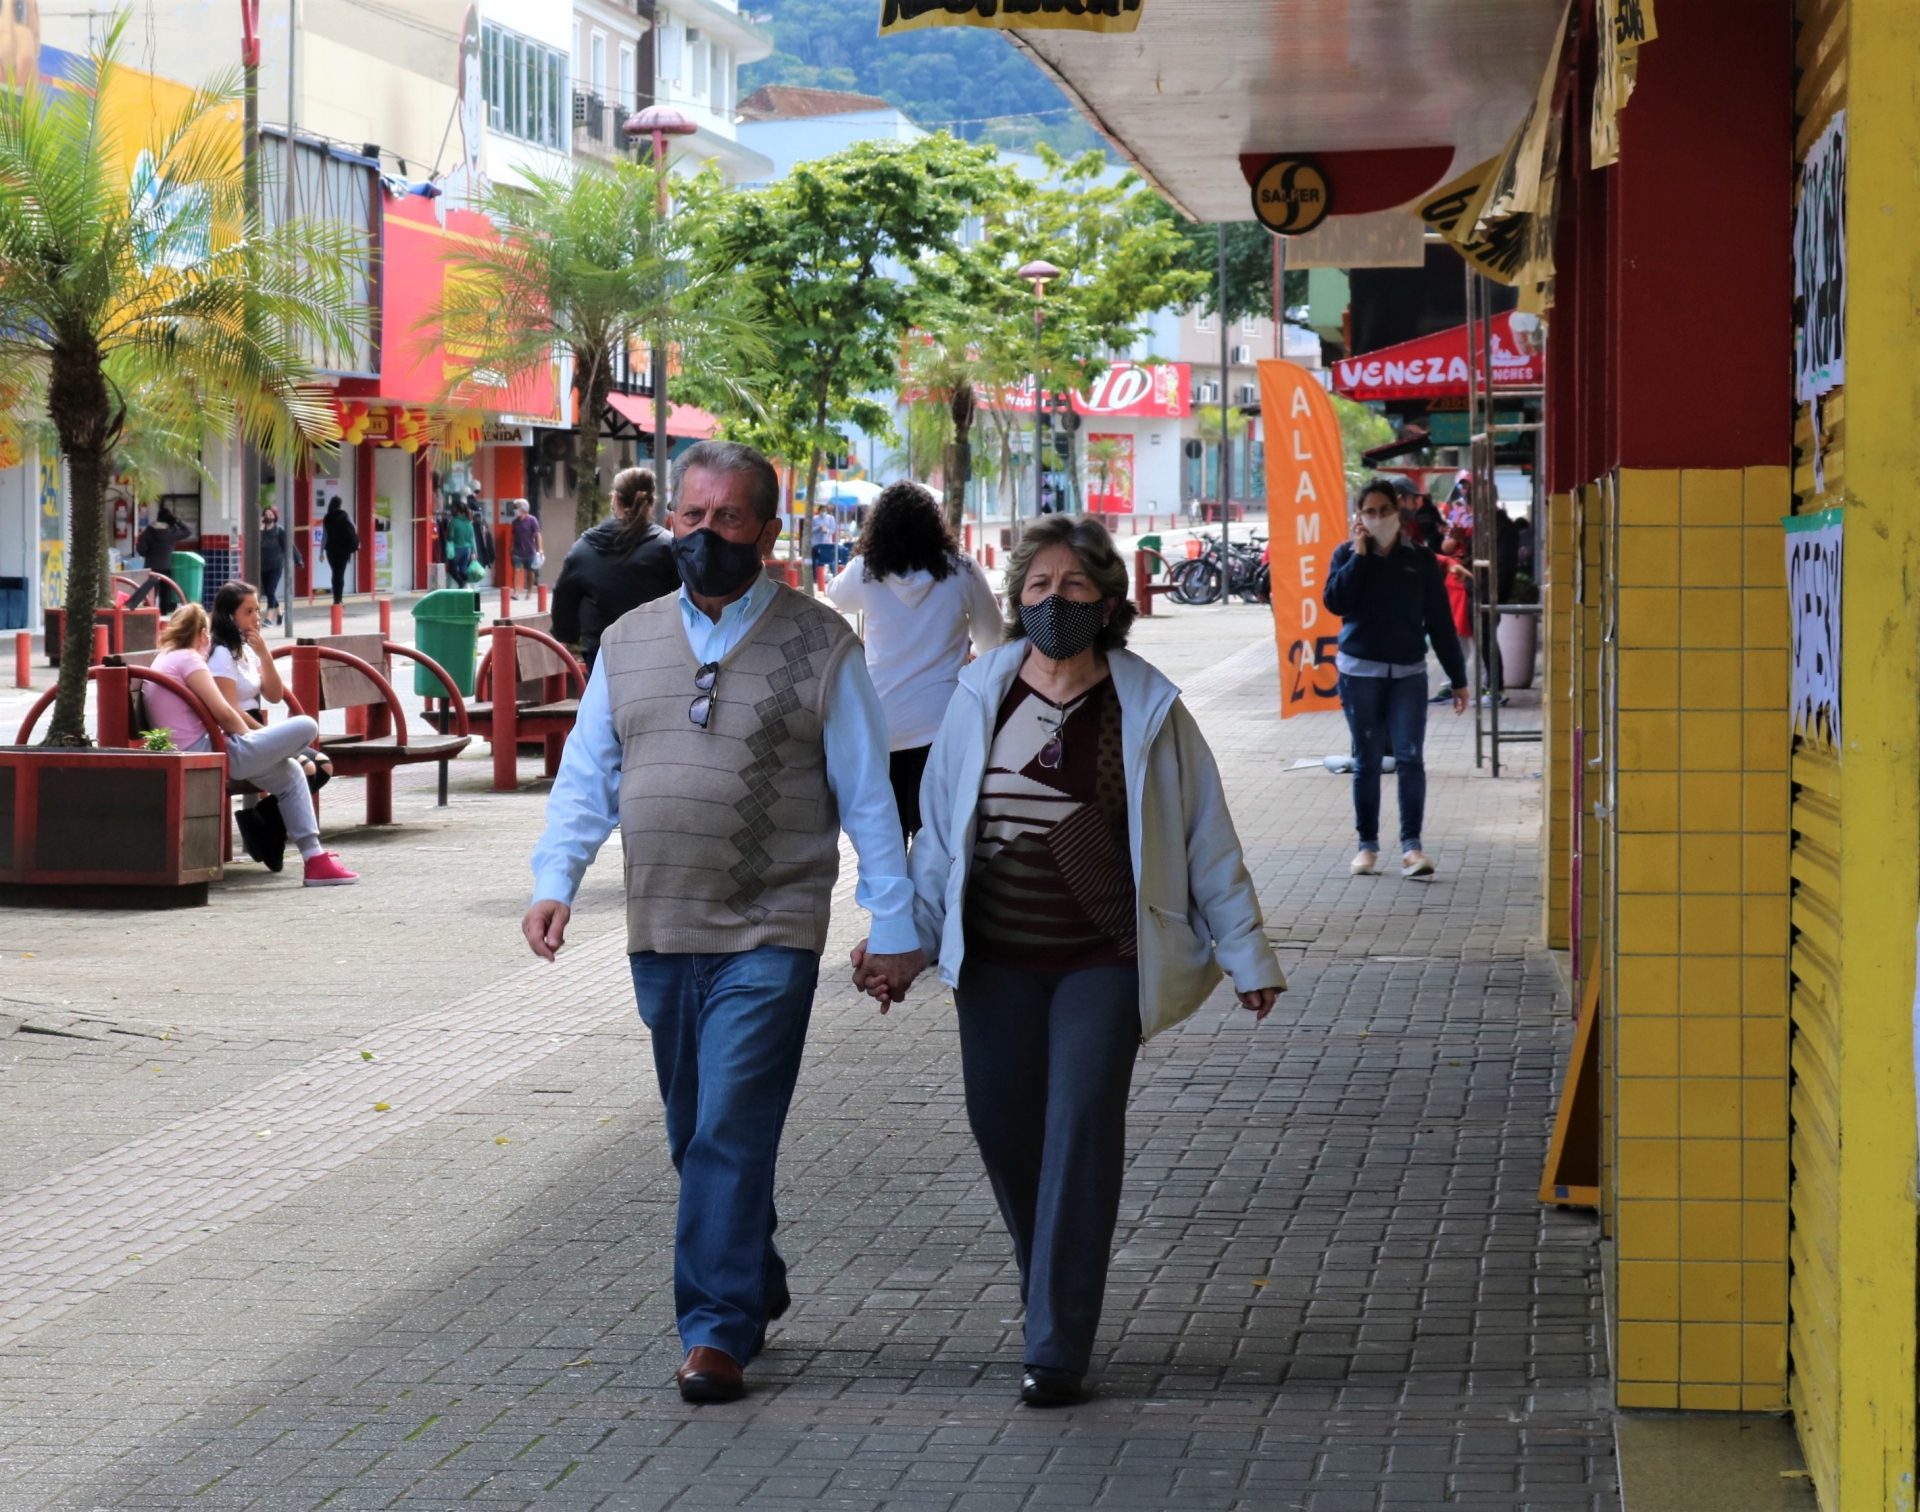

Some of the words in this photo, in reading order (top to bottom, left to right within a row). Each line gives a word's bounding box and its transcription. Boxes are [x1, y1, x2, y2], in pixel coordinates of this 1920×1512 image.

[1261, 188, 1320, 203] SALFER
[1088, 366, 1147, 410] 10
[1475, 367, 1534, 382] LNCHES
[1290, 387, 1321, 673] ALAMEDA
